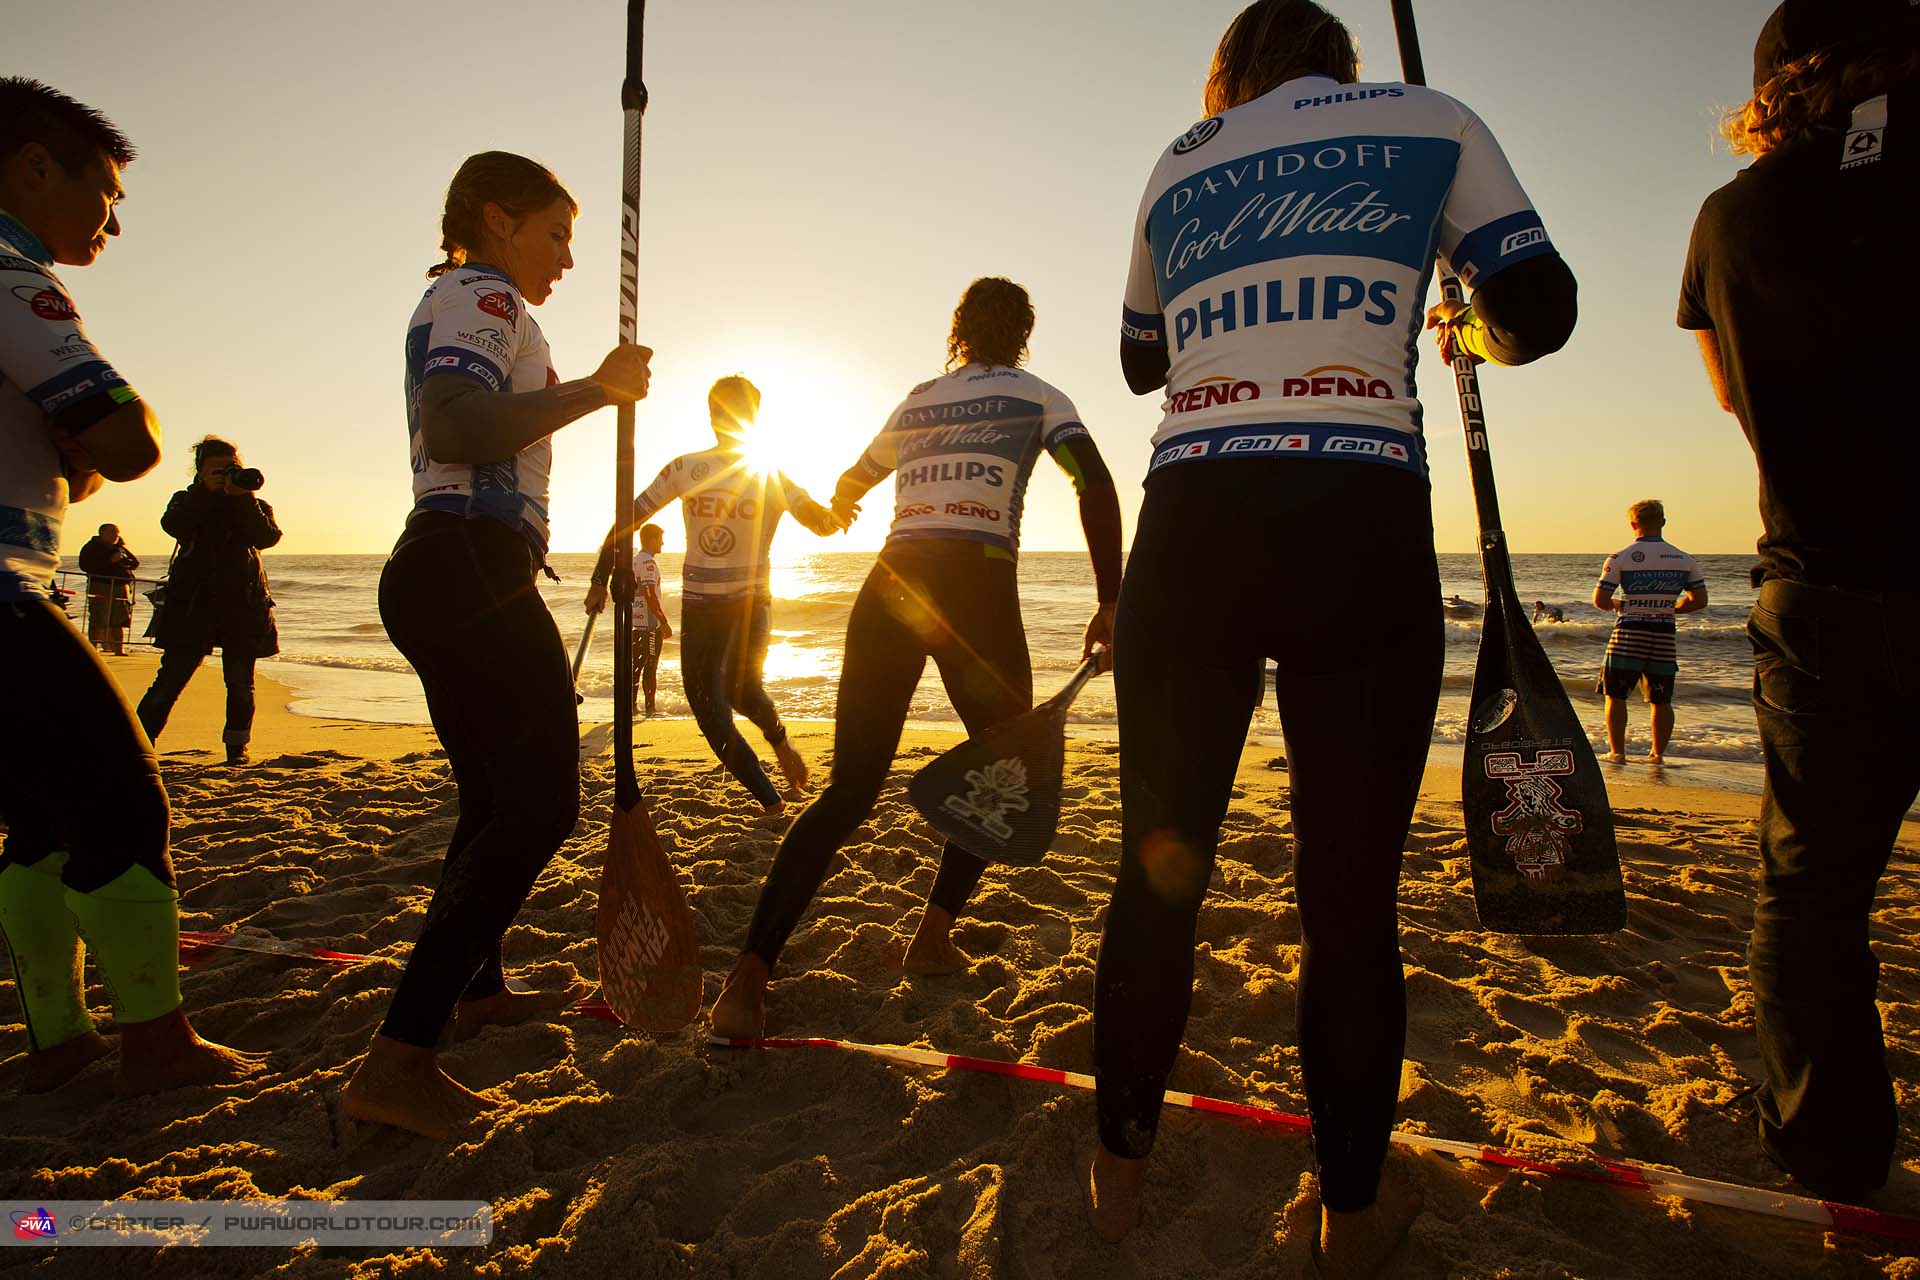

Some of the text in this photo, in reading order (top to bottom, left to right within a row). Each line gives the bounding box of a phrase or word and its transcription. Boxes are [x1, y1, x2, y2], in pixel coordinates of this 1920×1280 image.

[1293, 88, 1405, 110] PHILIPS
[1840, 154, 1882, 170] MYSTIC
[1172, 144, 1403, 216] DAVIDOFF
[1166, 181, 1411, 279] Cool Water
[1175, 275, 1398, 353] PHILIPS
[1171, 379, 1261, 414] RENO
[902, 400, 1008, 426] DAVIDOFF
[898, 461, 1003, 493] PHILIPS
[684, 496, 758, 520] RENO
[944, 502, 1000, 522] RENO
